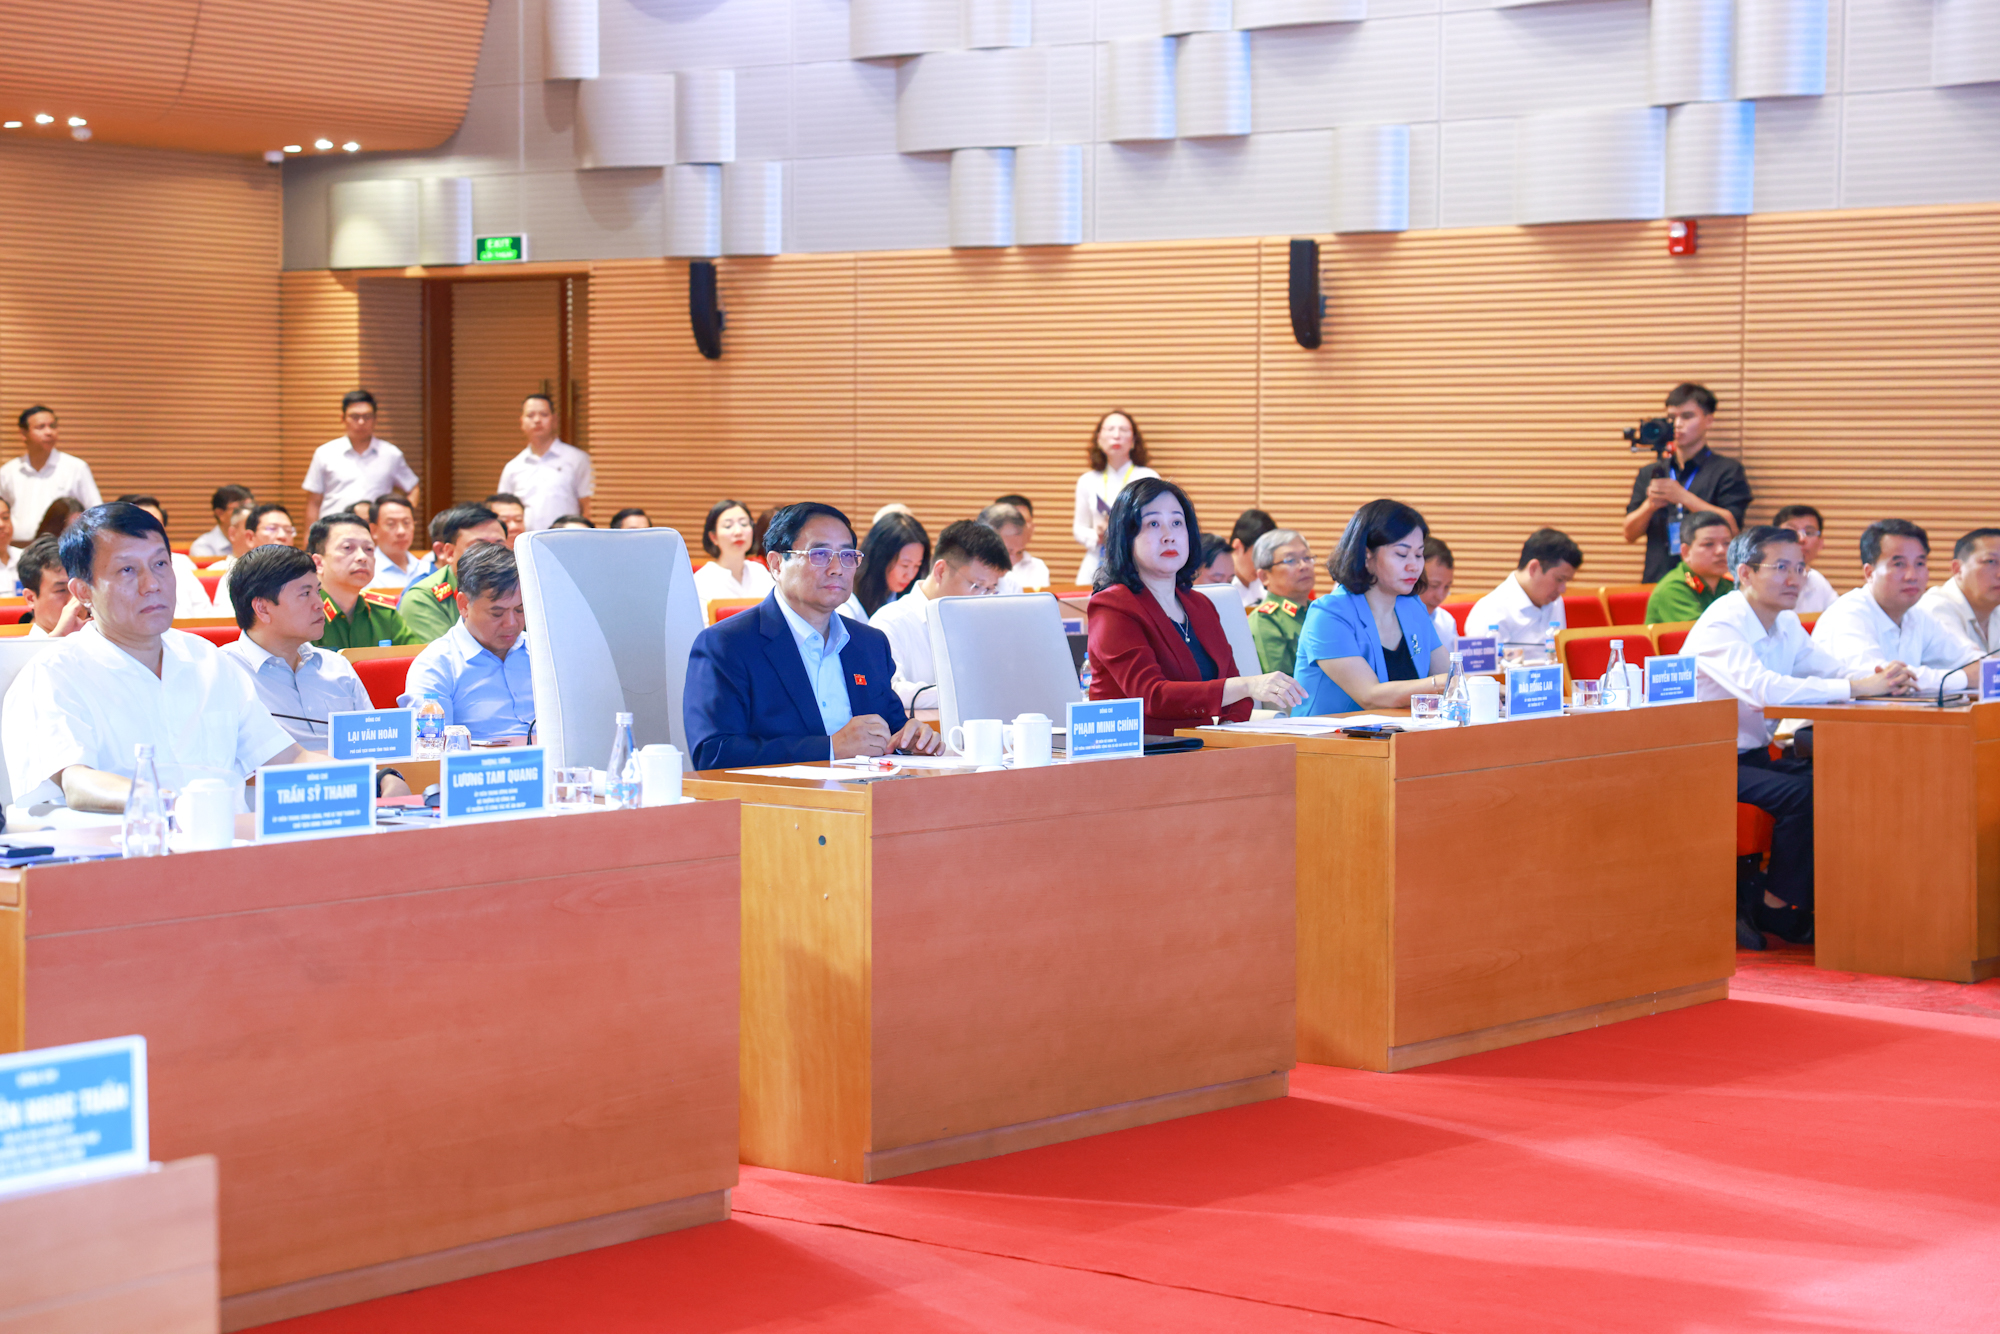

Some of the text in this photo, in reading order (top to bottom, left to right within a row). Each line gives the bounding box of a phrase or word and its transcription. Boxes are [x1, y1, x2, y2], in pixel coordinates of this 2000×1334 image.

[348, 727, 398, 743] LẠI VĂN HOÀN
[1074, 717, 1138, 737] PHẠM MINH CHÍNH
[453, 767, 538, 787] LƯƠNG TAM QUANG
[307, 784, 321, 801] SỸ
[323, 784, 357, 800] THANH
